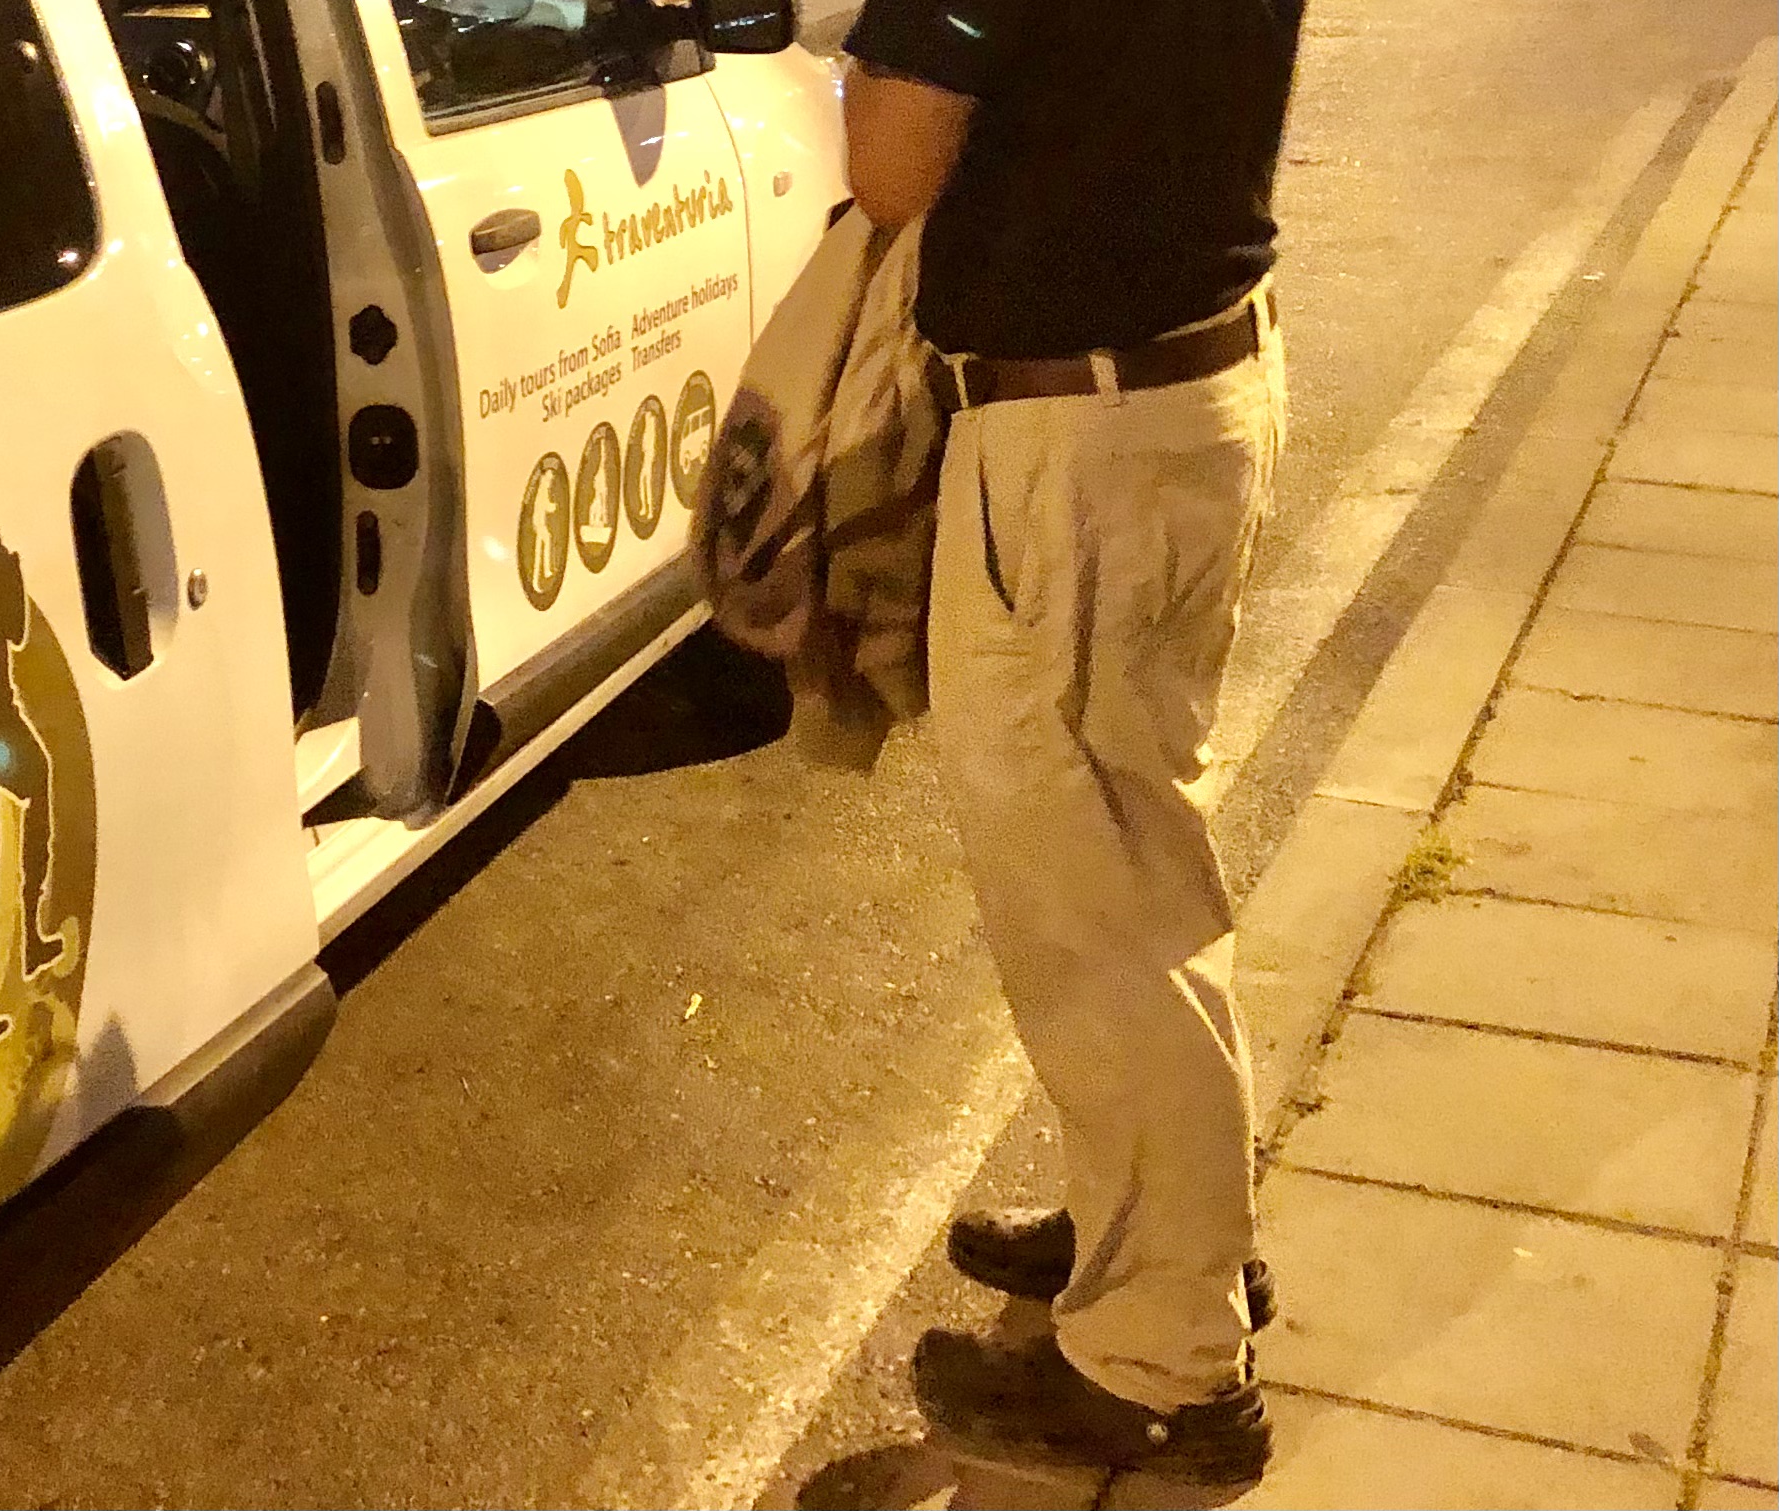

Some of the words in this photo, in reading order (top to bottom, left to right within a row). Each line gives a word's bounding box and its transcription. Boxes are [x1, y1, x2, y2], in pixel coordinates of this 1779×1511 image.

[602, 170, 733, 265] traventuria
[631, 295, 689, 340] Adventure
[691, 273, 738, 316] holidays
[479, 377, 517, 419] Daily
[520, 364, 556, 397] tours
[558, 346, 589, 378] from
[592, 325, 622, 362] Sofia
[631, 328, 682, 372] Transfers
[542, 393, 562, 422] Ski
[565, 361, 622, 417] packages
